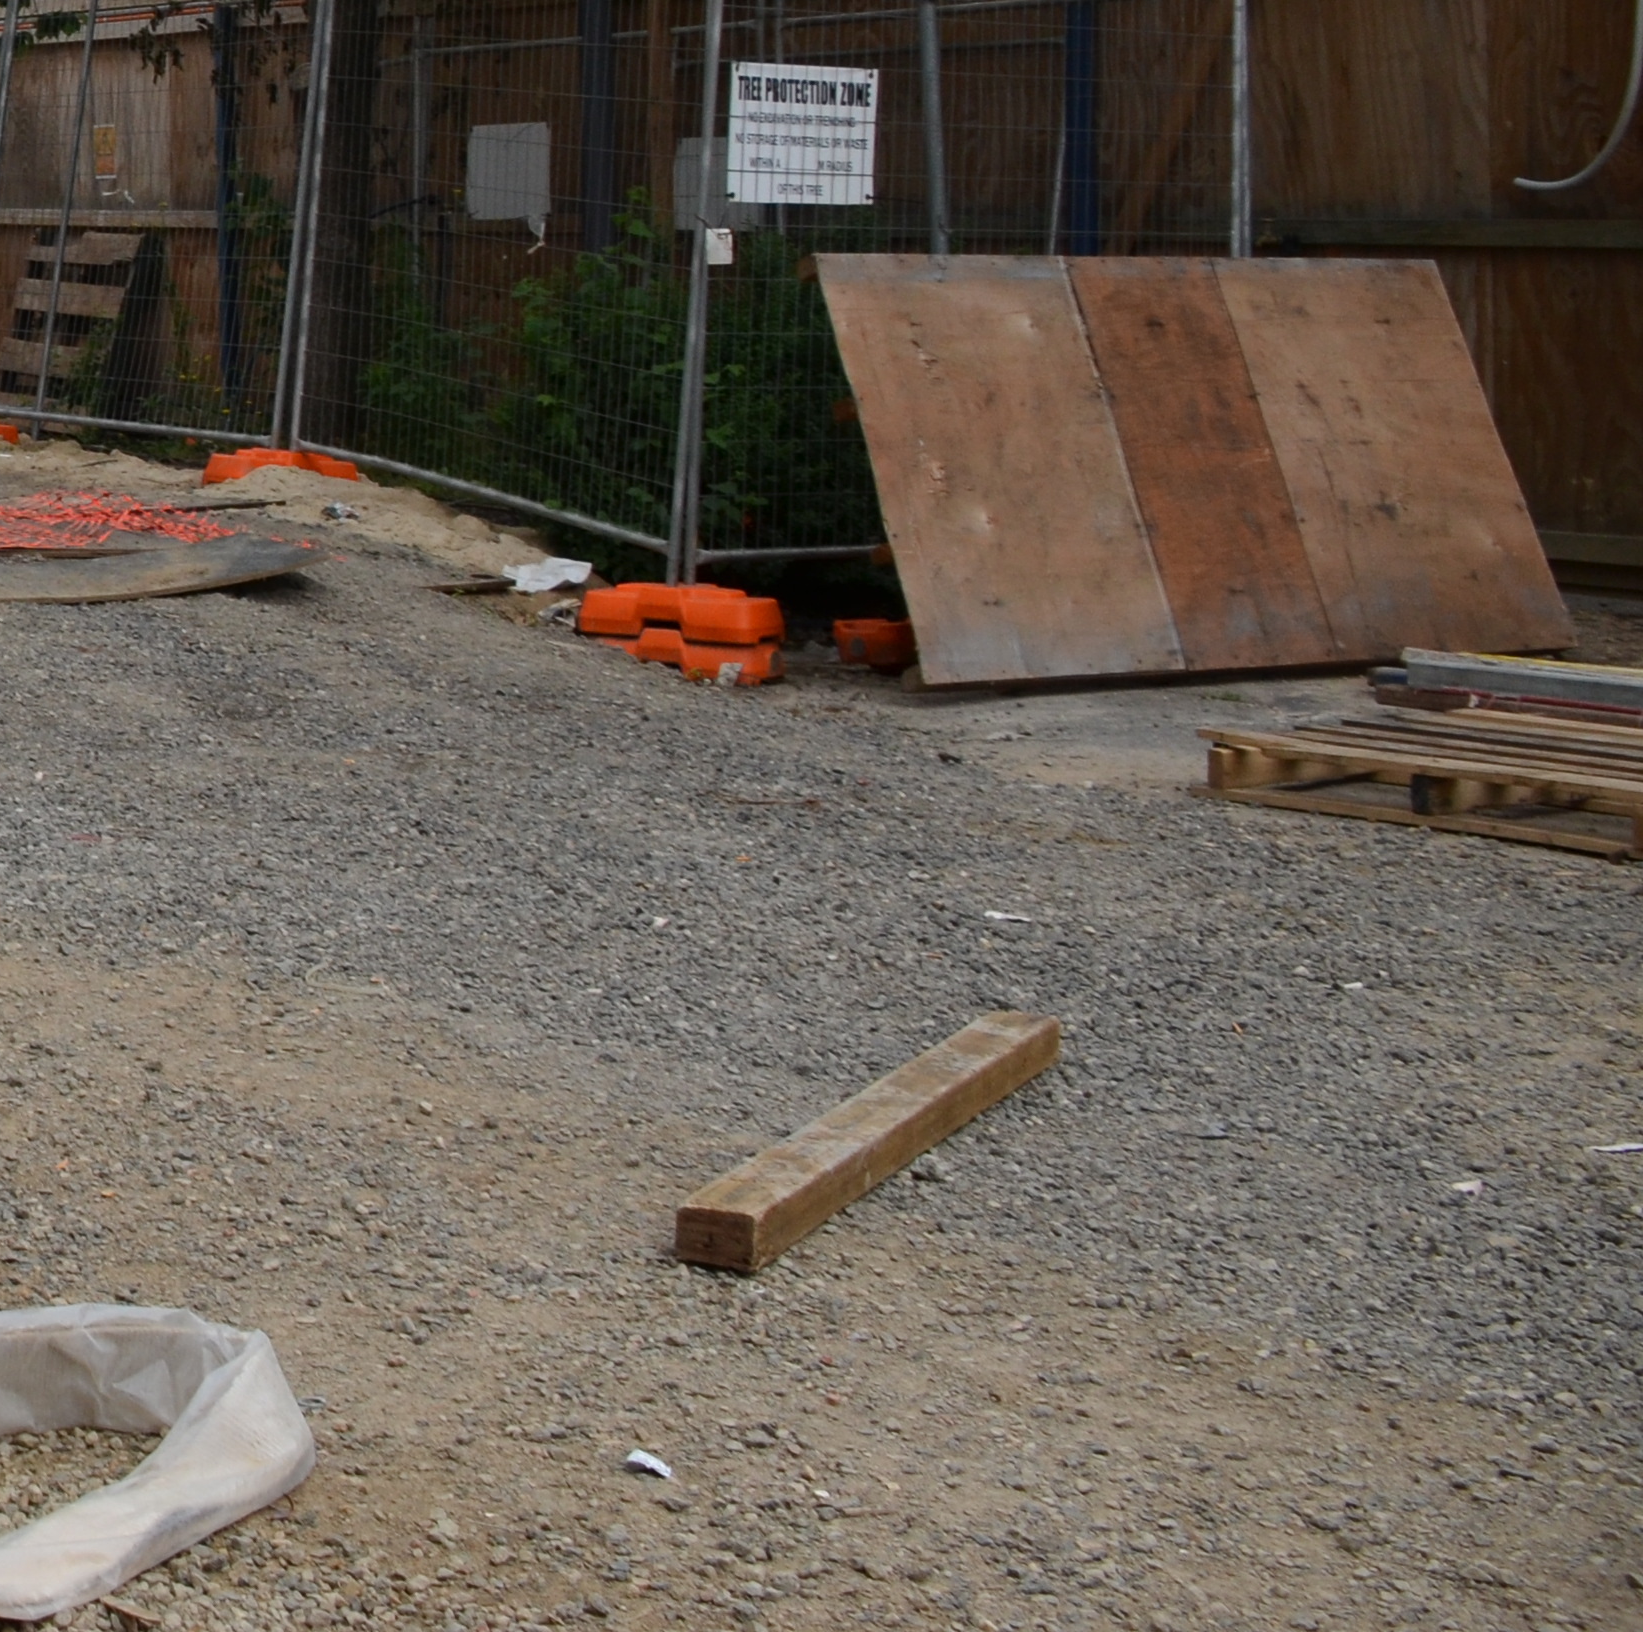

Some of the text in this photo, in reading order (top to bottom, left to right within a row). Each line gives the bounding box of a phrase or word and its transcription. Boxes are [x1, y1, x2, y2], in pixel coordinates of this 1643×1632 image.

[738, 76, 871, 107] TREE PROTECTION ZONE
[759, 113, 800, 125] EXCAVATION
[802, 115, 813, 125] OR
[815, 115, 856, 127] TRENCHING
[736, 133, 745, 144] NO
[746, 133, 778, 146] STORAGE
[790, 135, 830, 148] MATERIALS
[832, 138, 841, 148] OR
[844, 138, 868, 150] WASTE
[749, 157, 773, 168] WITHIN
[826, 160, 853, 172] RADIUS
[777, 183, 823, 196] OF THIS TREE
